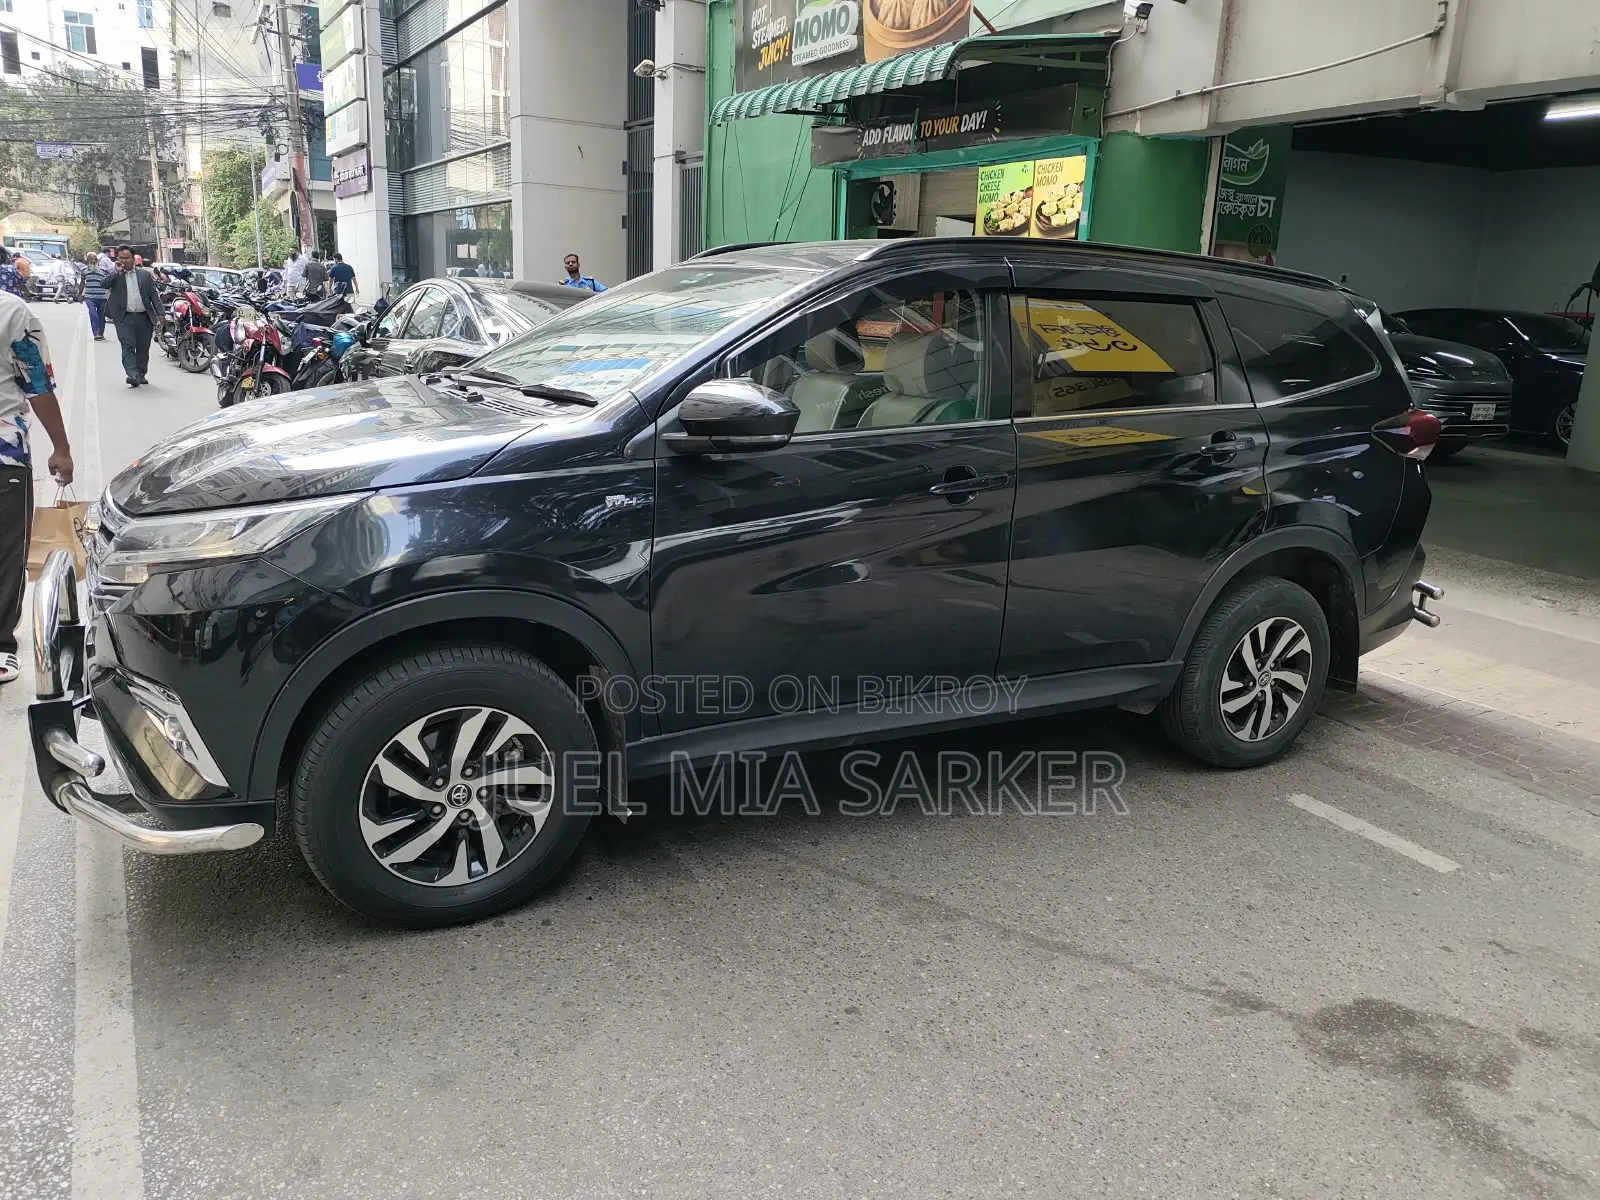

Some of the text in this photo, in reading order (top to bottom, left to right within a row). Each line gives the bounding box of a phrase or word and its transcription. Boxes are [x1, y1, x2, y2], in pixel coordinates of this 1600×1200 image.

[751, 4, 768, 29] HOT.
[793, 4, 851, 50] MOMO
[751, 15, 789, 50] STEAMED.
[758, 31, 792, 71] JUICY!
[792, 38, 850, 63] STEAMED GOODNESS
[862, 128, 882, 147] ADD
[920, 118, 933, 138] TO
[933, 115, 960, 137] YOUR
[960, 109, 988, 133] DAY!
[980, 167, 1006, 182] CHICKEN
[1037, 161, 1065, 175] CHICKEN
[979, 180, 1002, 193] CHEESE
[1036, 175, 1059, 188] MOMO
[978, 193, 1000, 204] MOMO
